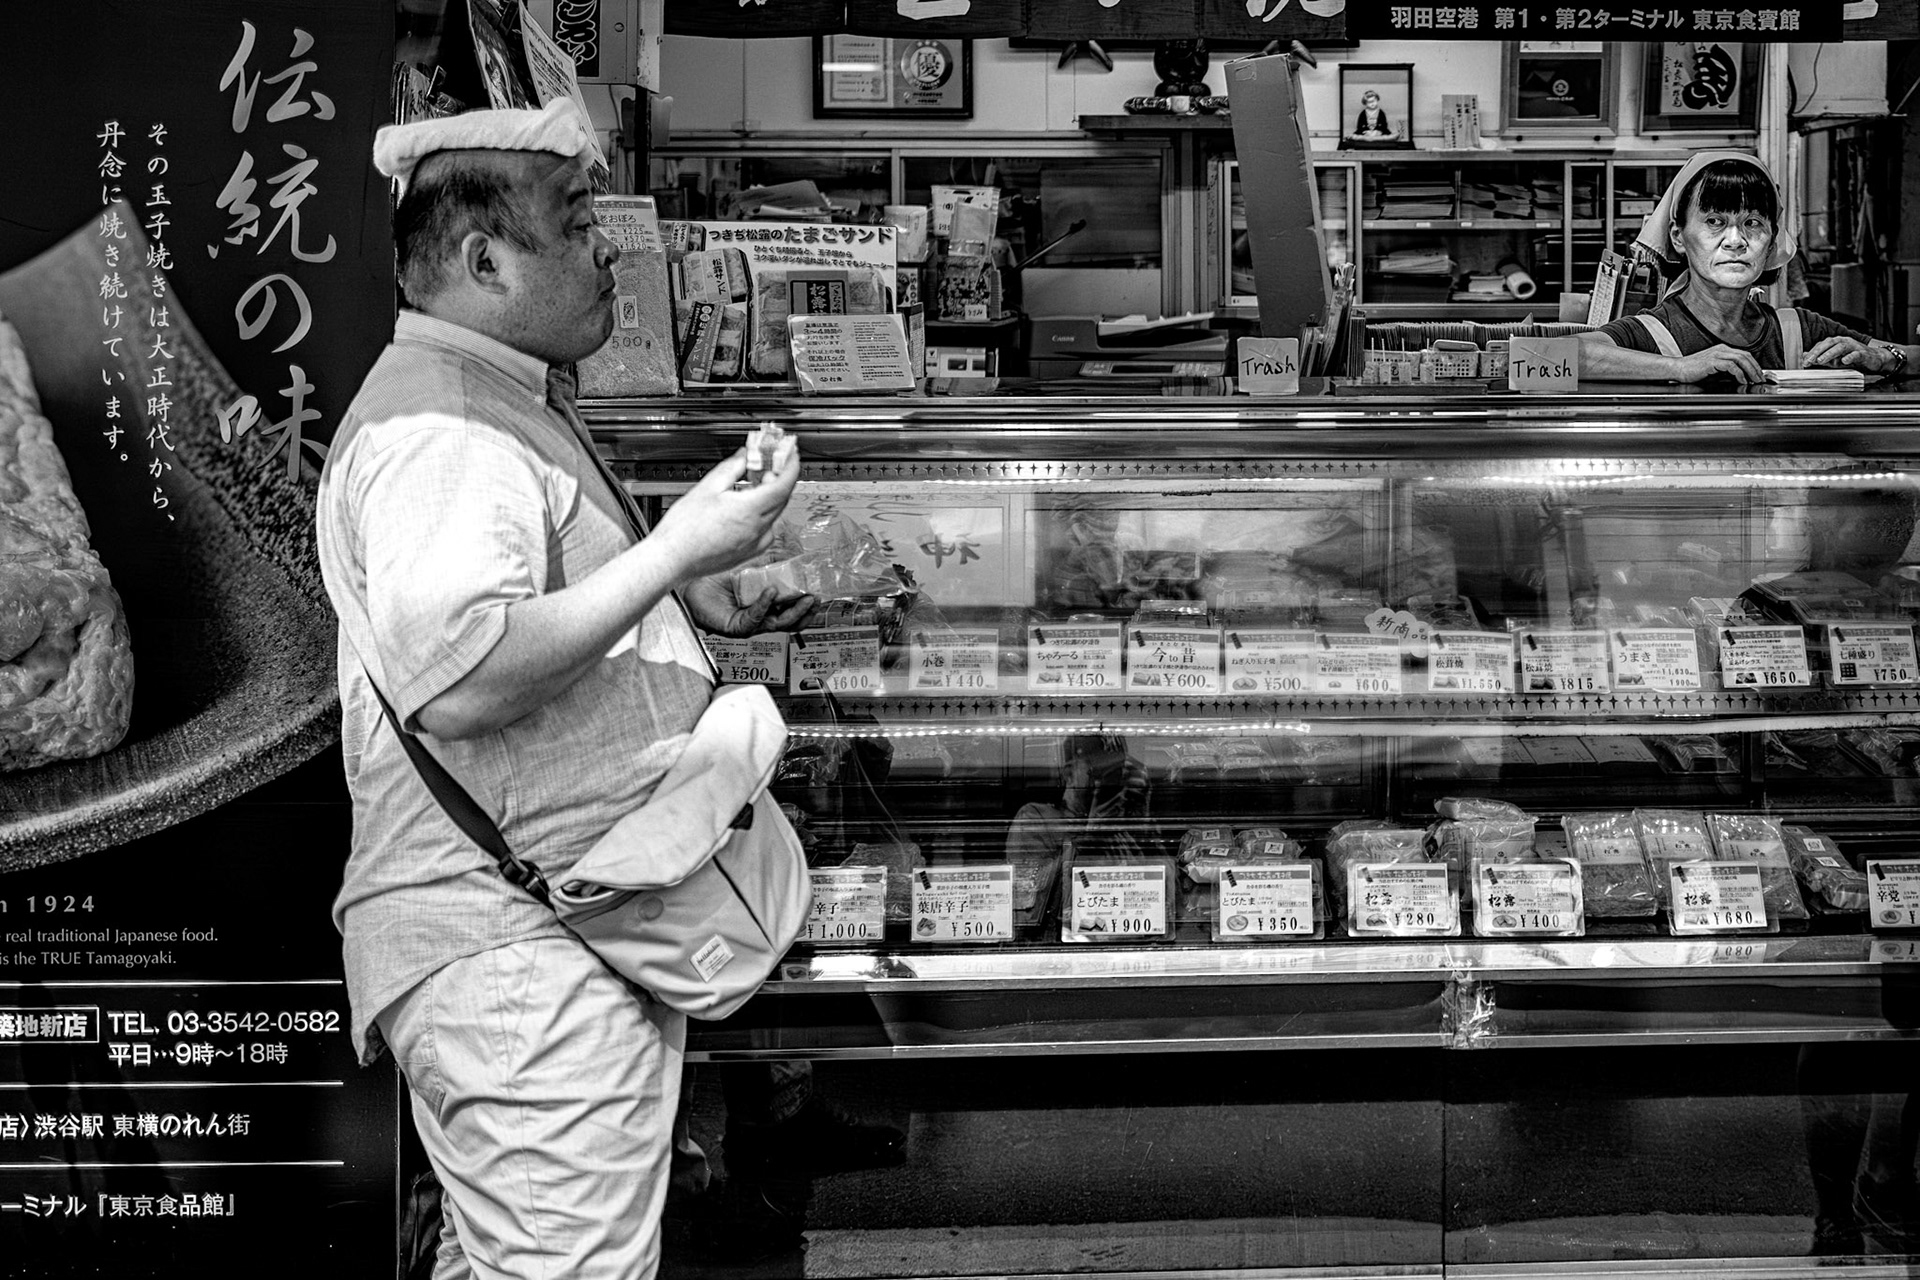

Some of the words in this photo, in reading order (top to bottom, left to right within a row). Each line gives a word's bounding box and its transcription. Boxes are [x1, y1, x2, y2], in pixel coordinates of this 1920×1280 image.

[1391, 6, 1479, 30] 羽田空港
[1495, 6, 1684, 30] 第1・第2ターミナル
[1693, 7, 1801, 31] 東京食賓館
[207, 19, 336, 483] 伝統の味
[96, 121, 128, 462] 丹念に焼き続けています。
[146, 123, 175, 522] その玉子焼きは大正時代から、
[1052, 334, 1075, 342] Canon
[1241, 354, 1296, 376] Trash
[1512, 358, 1573, 378] Trash
[1376, 615, 1428, 640] 新商品
[1152, 647, 1167, 662] 今
[1182, 647, 1196, 663] 昔
[1618, 652, 1651, 663] うまき
[731, 667, 770, 680] ¥500
[945, 674, 984, 687] ¥440
[1067, 673, 1104, 687] ¥450
[1163, 673, 1206, 688] ¥600
[1763, 671, 1796, 684] ¥650
[1874, 668, 1907, 681] ¥750
[833, 675, 868, 689] ¥600
[1264, 677, 1301, 690] ¥500
[1356, 679, 1389, 691] ¥600
[1561, 677, 1593, 690] ¥815
[27, 895, 94, 912] 1924
[917, 901, 969, 914] 葉唐辛子
[1077, 896, 1119, 908] とびたま
[1222, 897, 1255, 906] とびたま
[1112, 918, 1151, 932] ¥900
[1258, 917, 1297, 931] ¥350
[1395, 912, 1434, 926] ¥280
[1520, 914, 1559, 928] ¥400
[1713, 911, 1752, 925] ¥680
[6, 929, 31, 942] real
[37, 928, 109, 942] traditional
[115, 929, 177, 945] Japanese
[182, 928, 218, 942] food.
[807, 922, 866, 938] ¥1,000
[952, 922, 994, 937] ¥500
[14, 952, 36, 964] the
[41, 952, 81, 964] TRUE
[86, 951, 176, 968] Tamagoyaki.
[108, 1012, 160, 1034] TEL.
[168, 1011, 340, 1033] 03-3542-0582
[113, 1113, 250, 1138] 東横のれん街
[99, 1193, 236, 1217] 『東京食品館』
